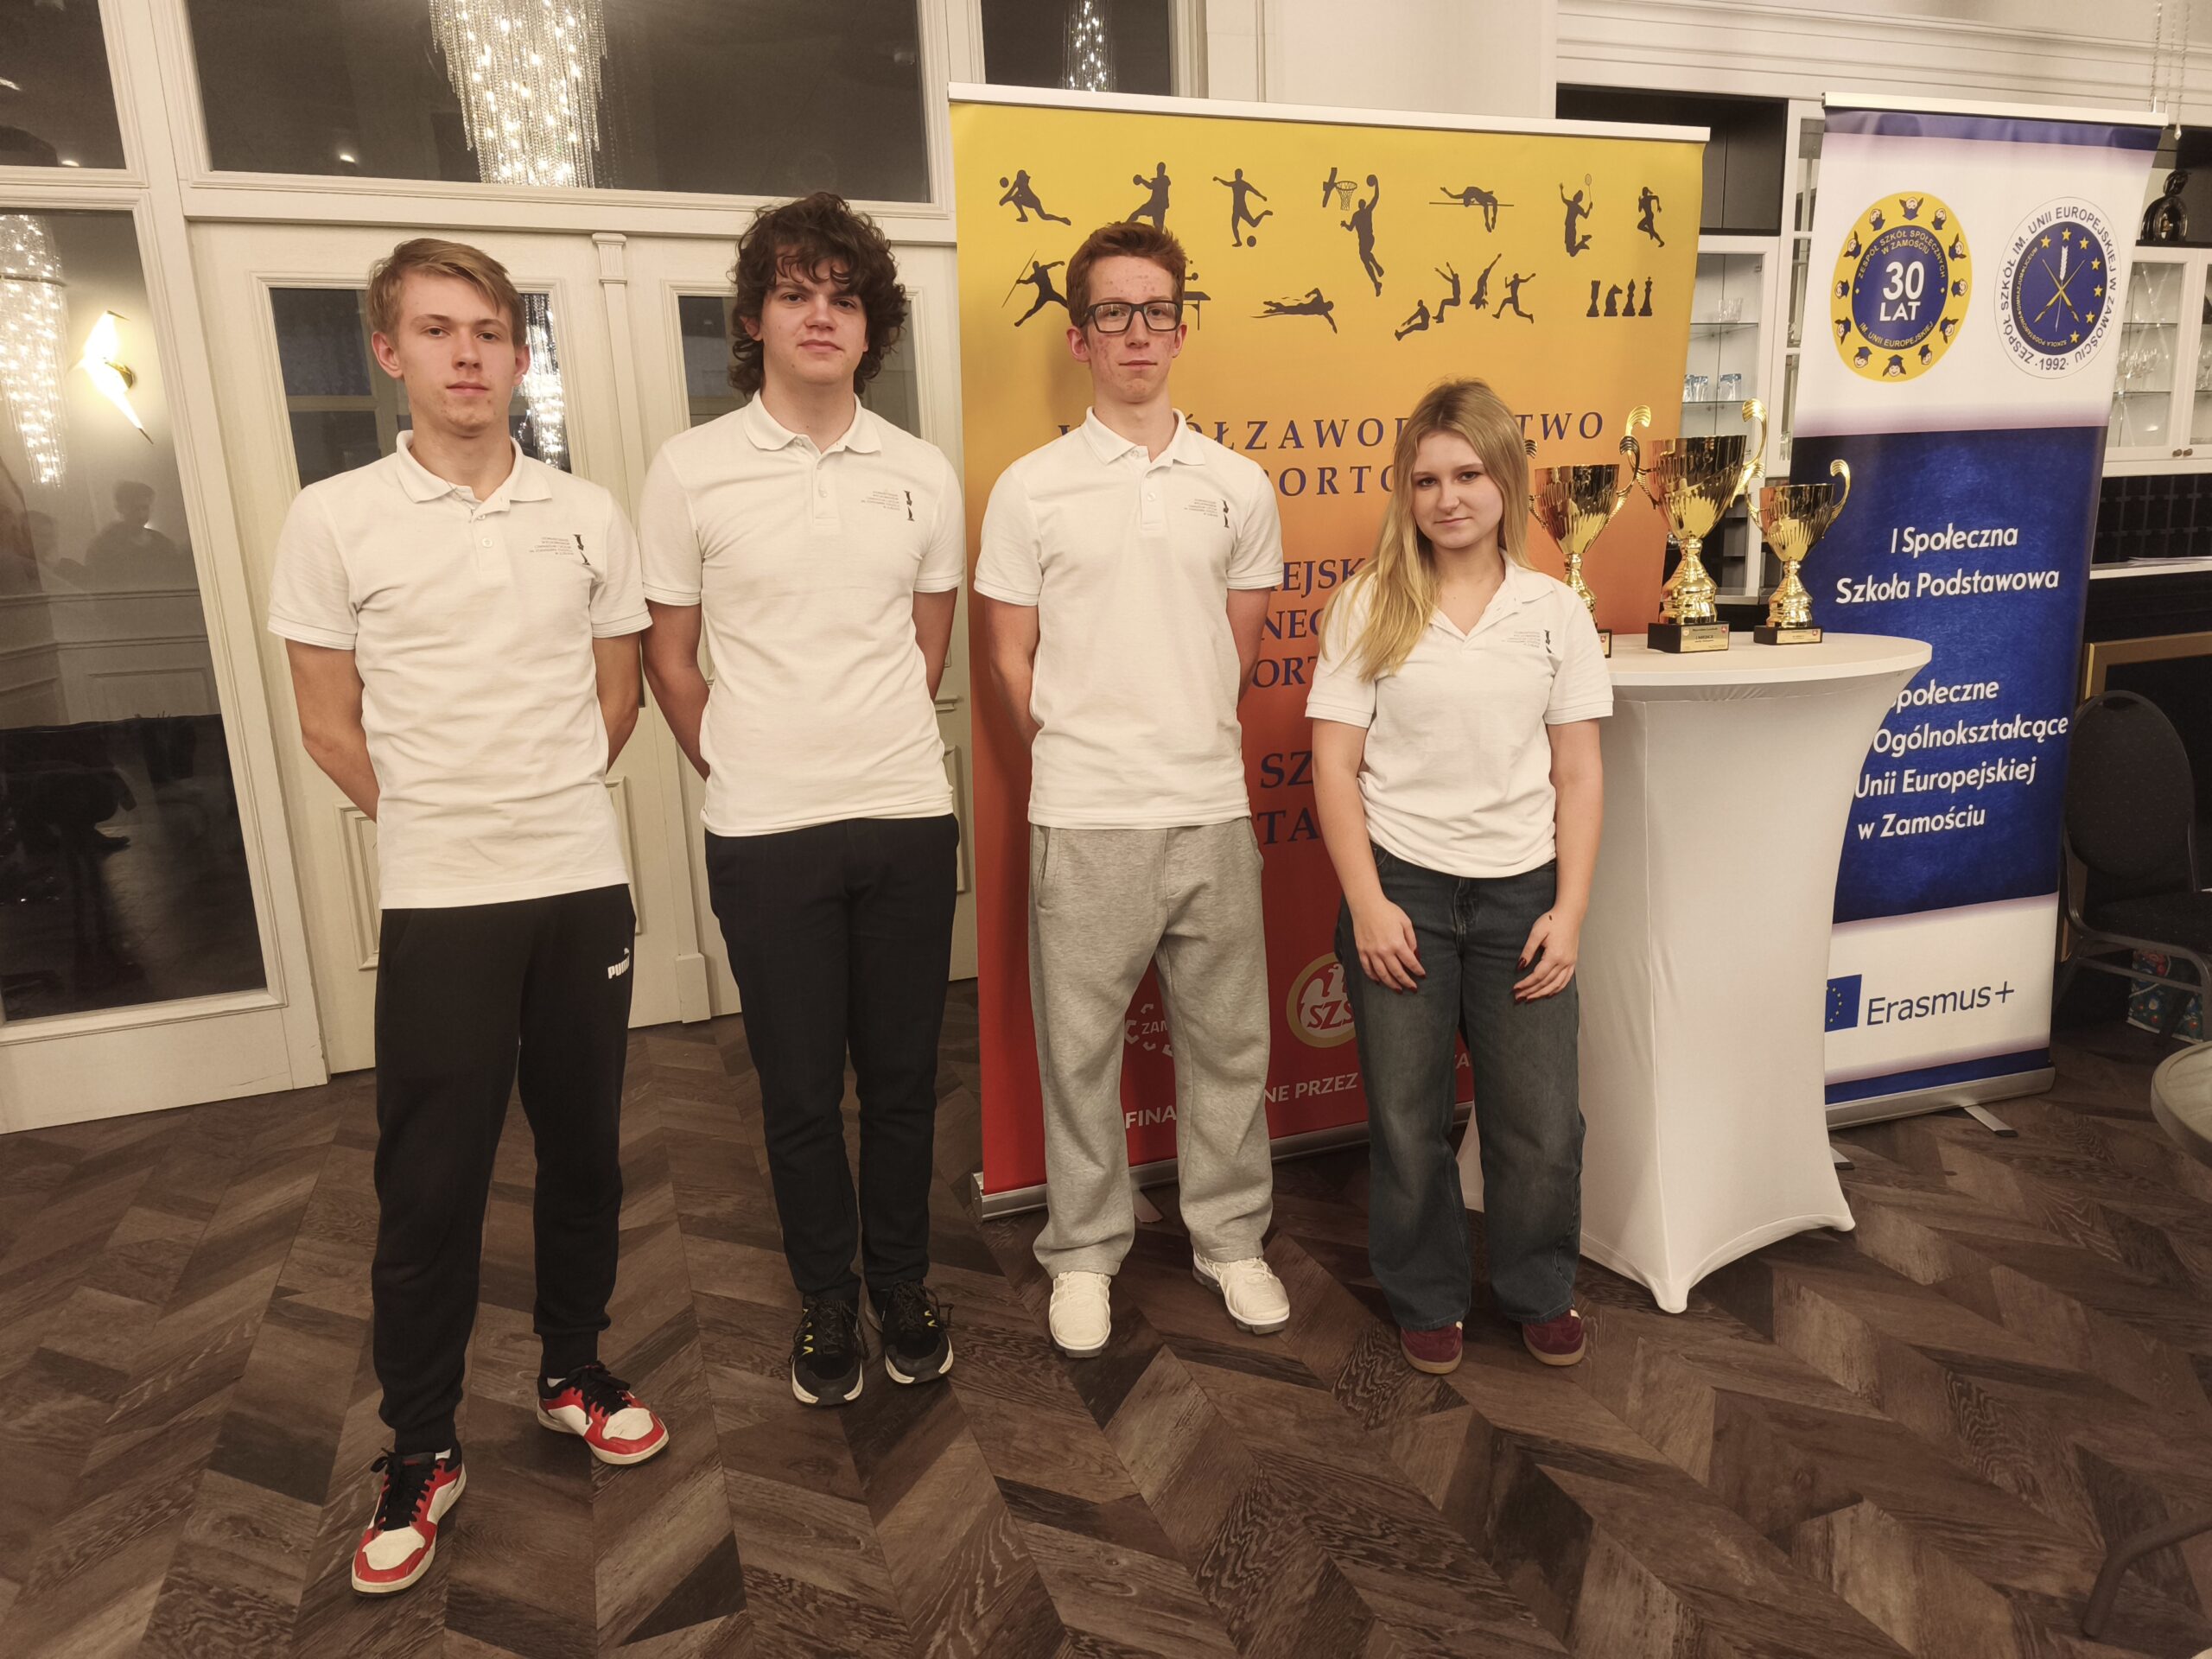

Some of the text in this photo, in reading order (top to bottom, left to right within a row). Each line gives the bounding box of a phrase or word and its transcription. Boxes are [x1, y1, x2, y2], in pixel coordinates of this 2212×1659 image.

[1859, 230, 1946, 279] ZESPÓŁ SZKÓŁ SPOŁECZNYCH
[1890, 238, 1930, 255] ZAMOŚCIU
[1883, 261, 1925, 301] 30
[2000, 206, 2117, 365] ZESPÓŁ SZKÓŁ IM. UNII EUROPEJSKIEJ W ZAMOŚCIU
[1879, 301, 1922, 321] LAT
[1868, 332, 1883, 344] UNII
[1884, 321, 1934, 347] EUROPEJSKIEJ
[1901, 523, 2019, 559] Społeczna
[1835, 568, 2061, 605] Szkoła Podstawowa
[1890, 678, 2000, 714] połeczne
[1872, 713, 2069, 758] Ogólnokształcące
[1854, 756, 2037, 798] Unii Europejskiej
[1858, 805, 1986, 841] w Zamościu
[1866, 981, 2015, 1027] Erasmus+
[1295, 1072, 1358, 1099] PRZEZ
